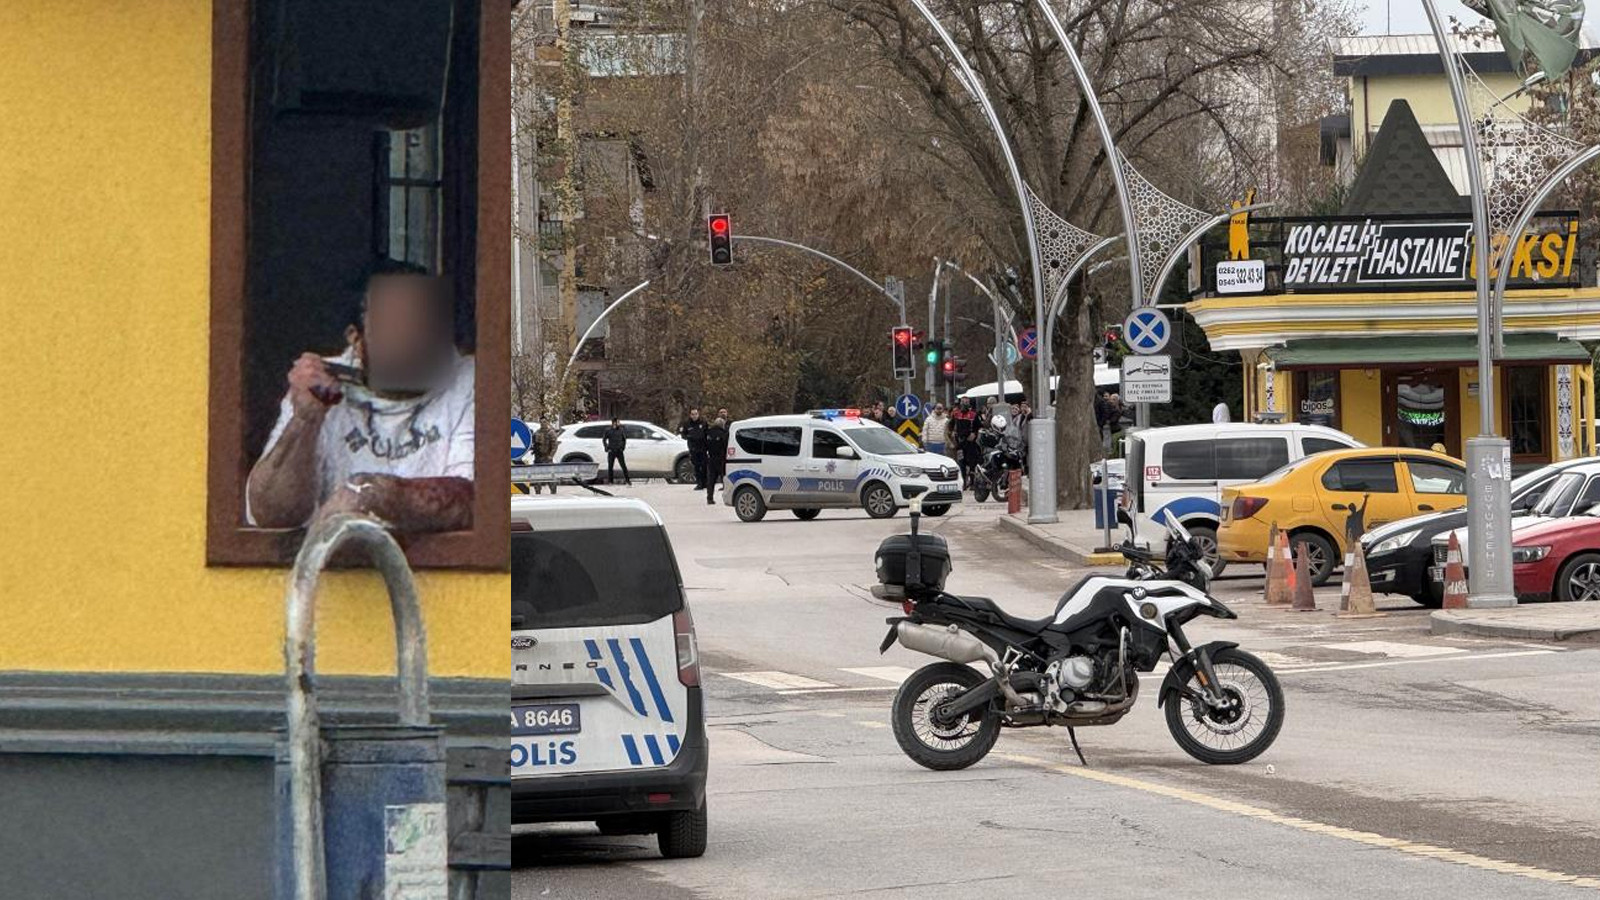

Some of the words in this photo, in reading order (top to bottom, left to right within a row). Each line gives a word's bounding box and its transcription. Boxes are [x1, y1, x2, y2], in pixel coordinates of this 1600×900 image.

[1284, 219, 1371, 254] KOCAELİ
[1284, 257, 1357, 283] DEVLET
[1368, 237, 1463, 275] HASTANE
[525, 709, 572, 726] 8646
